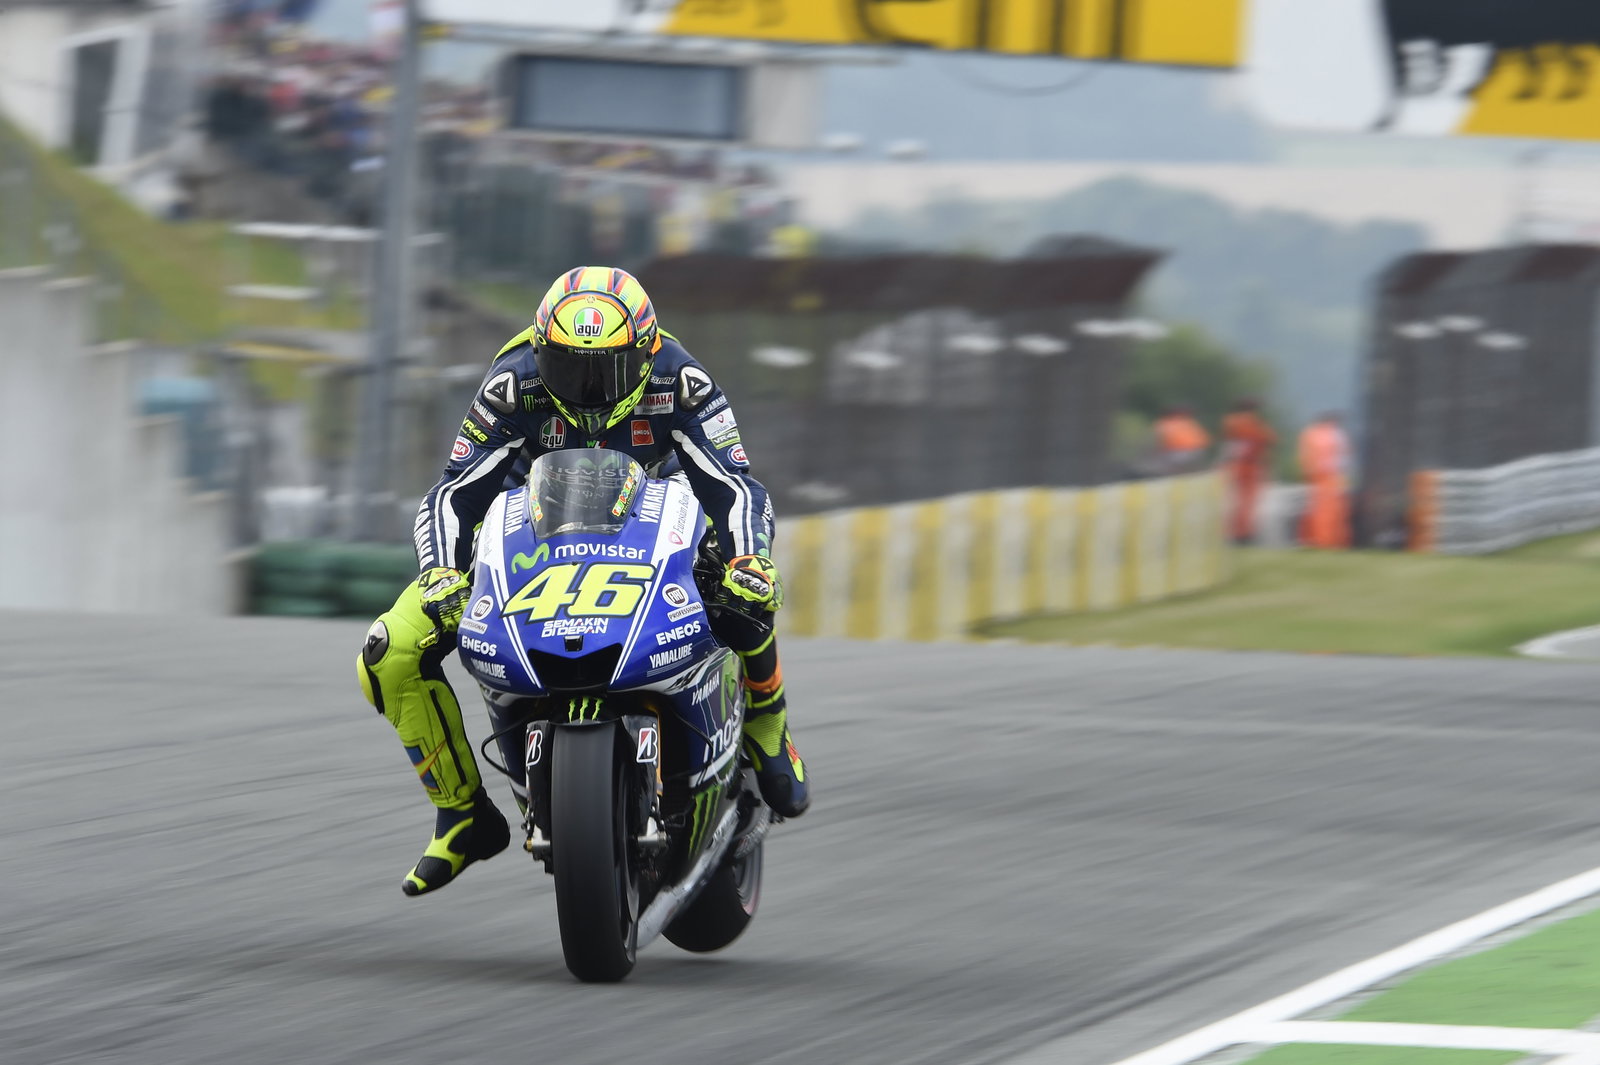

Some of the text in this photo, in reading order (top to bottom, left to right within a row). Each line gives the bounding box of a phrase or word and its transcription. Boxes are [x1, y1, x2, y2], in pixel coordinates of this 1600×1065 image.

[577, 325, 599, 336] agv
[542, 435, 562, 448] agv
[639, 482, 668, 523] YAMAHA
[504, 491, 526, 537] YAMAHA
[555, 543, 647, 560] movistar
[501, 562, 657, 623] 46
[668, 603, 702, 620] PROFESSIONAL
[541, 625, 607, 638] DI DEPAN
[543, 617, 609, 630] SEMAKIN
[655, 620, 702, 646] ENEOS
[461, 635, 498, 657] ENEOS
[650, 643, 693, 669] YAMALUBE
